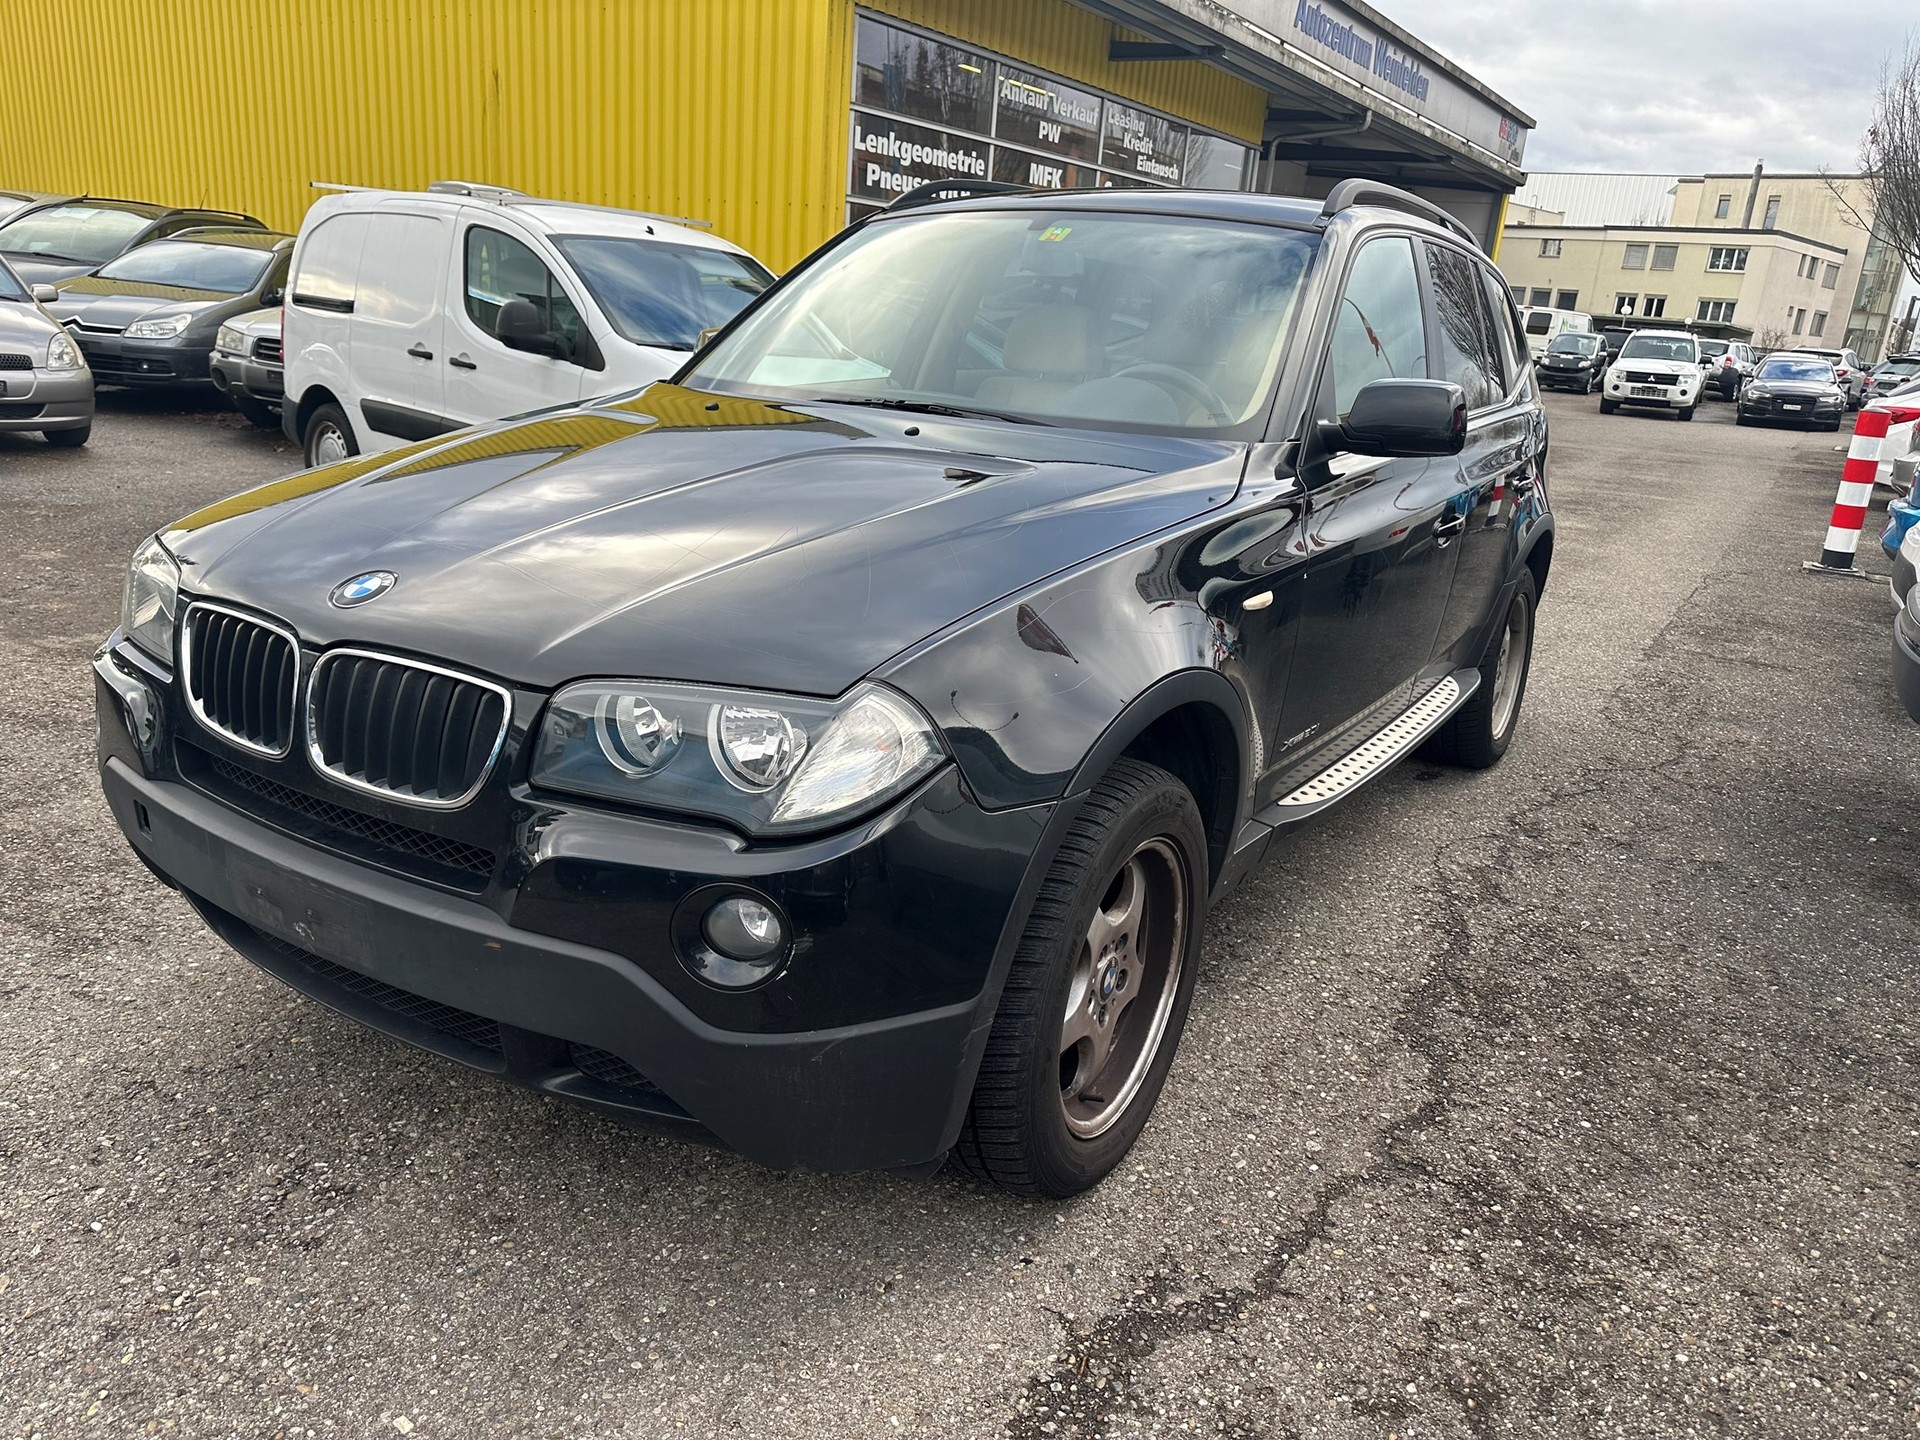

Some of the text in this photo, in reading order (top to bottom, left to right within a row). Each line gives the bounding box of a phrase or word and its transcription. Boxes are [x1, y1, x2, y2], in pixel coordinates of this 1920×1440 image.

[1293, 0, 1430, 103] Autozentrum Weinfelden
[1000, 79, 1100, 126] Ankauf Verkauf
[1039, 120, 1062, 144] PW
[1108, 107, 1145, 137] Leasing
[854, 125, 986, 177] Lenkgeometrie
[1122, 132, 1153, 155] Kredit
[1028, 162, 1063, 189] MFK
[1136, 155, 1179, 181] Eintausch
